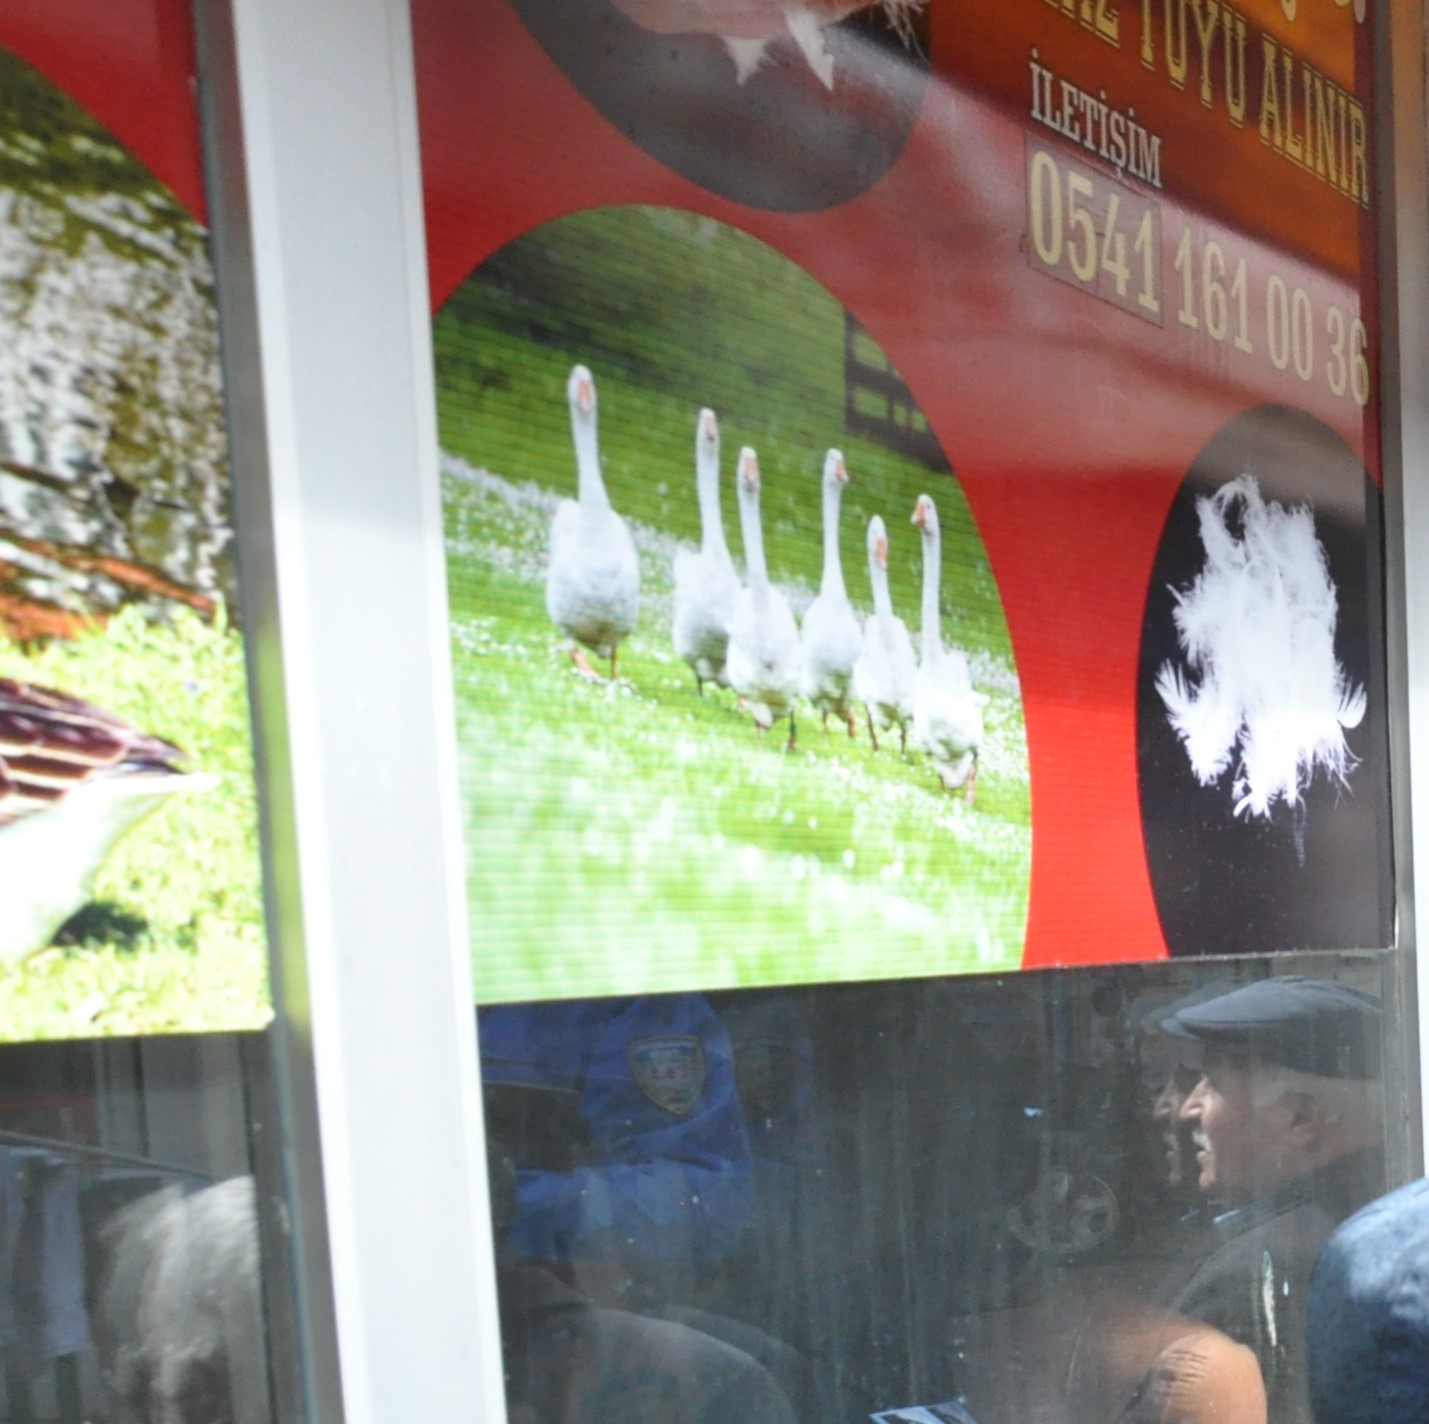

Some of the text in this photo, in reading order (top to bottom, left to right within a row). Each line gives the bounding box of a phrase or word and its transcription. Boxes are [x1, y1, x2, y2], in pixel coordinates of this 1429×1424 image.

[1029, 48, 1162, 188] İLETİŞİM
[1259, 32, 1369, 209] ALINIR
[1030, 151, 1370, 406] 0541 161 00 36
